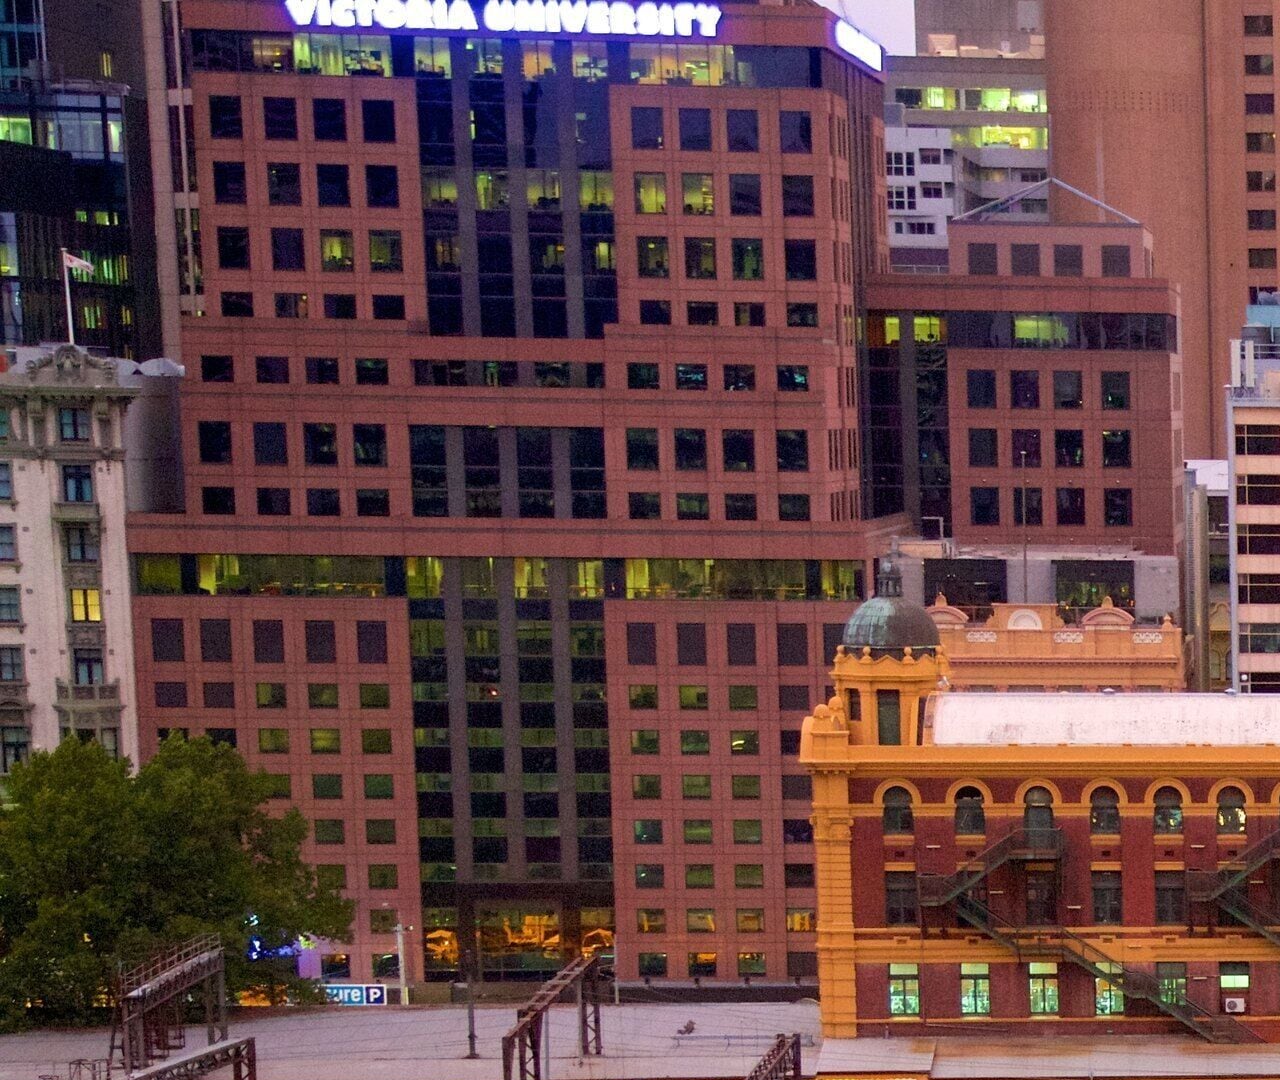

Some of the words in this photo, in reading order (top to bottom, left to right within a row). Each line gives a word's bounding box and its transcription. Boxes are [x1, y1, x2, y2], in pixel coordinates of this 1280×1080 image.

[284, 0, 479, 30] VICTORIA
[484, 0, 722, 37] UNIVERSITY
[369, 988, 382, 1002] P
